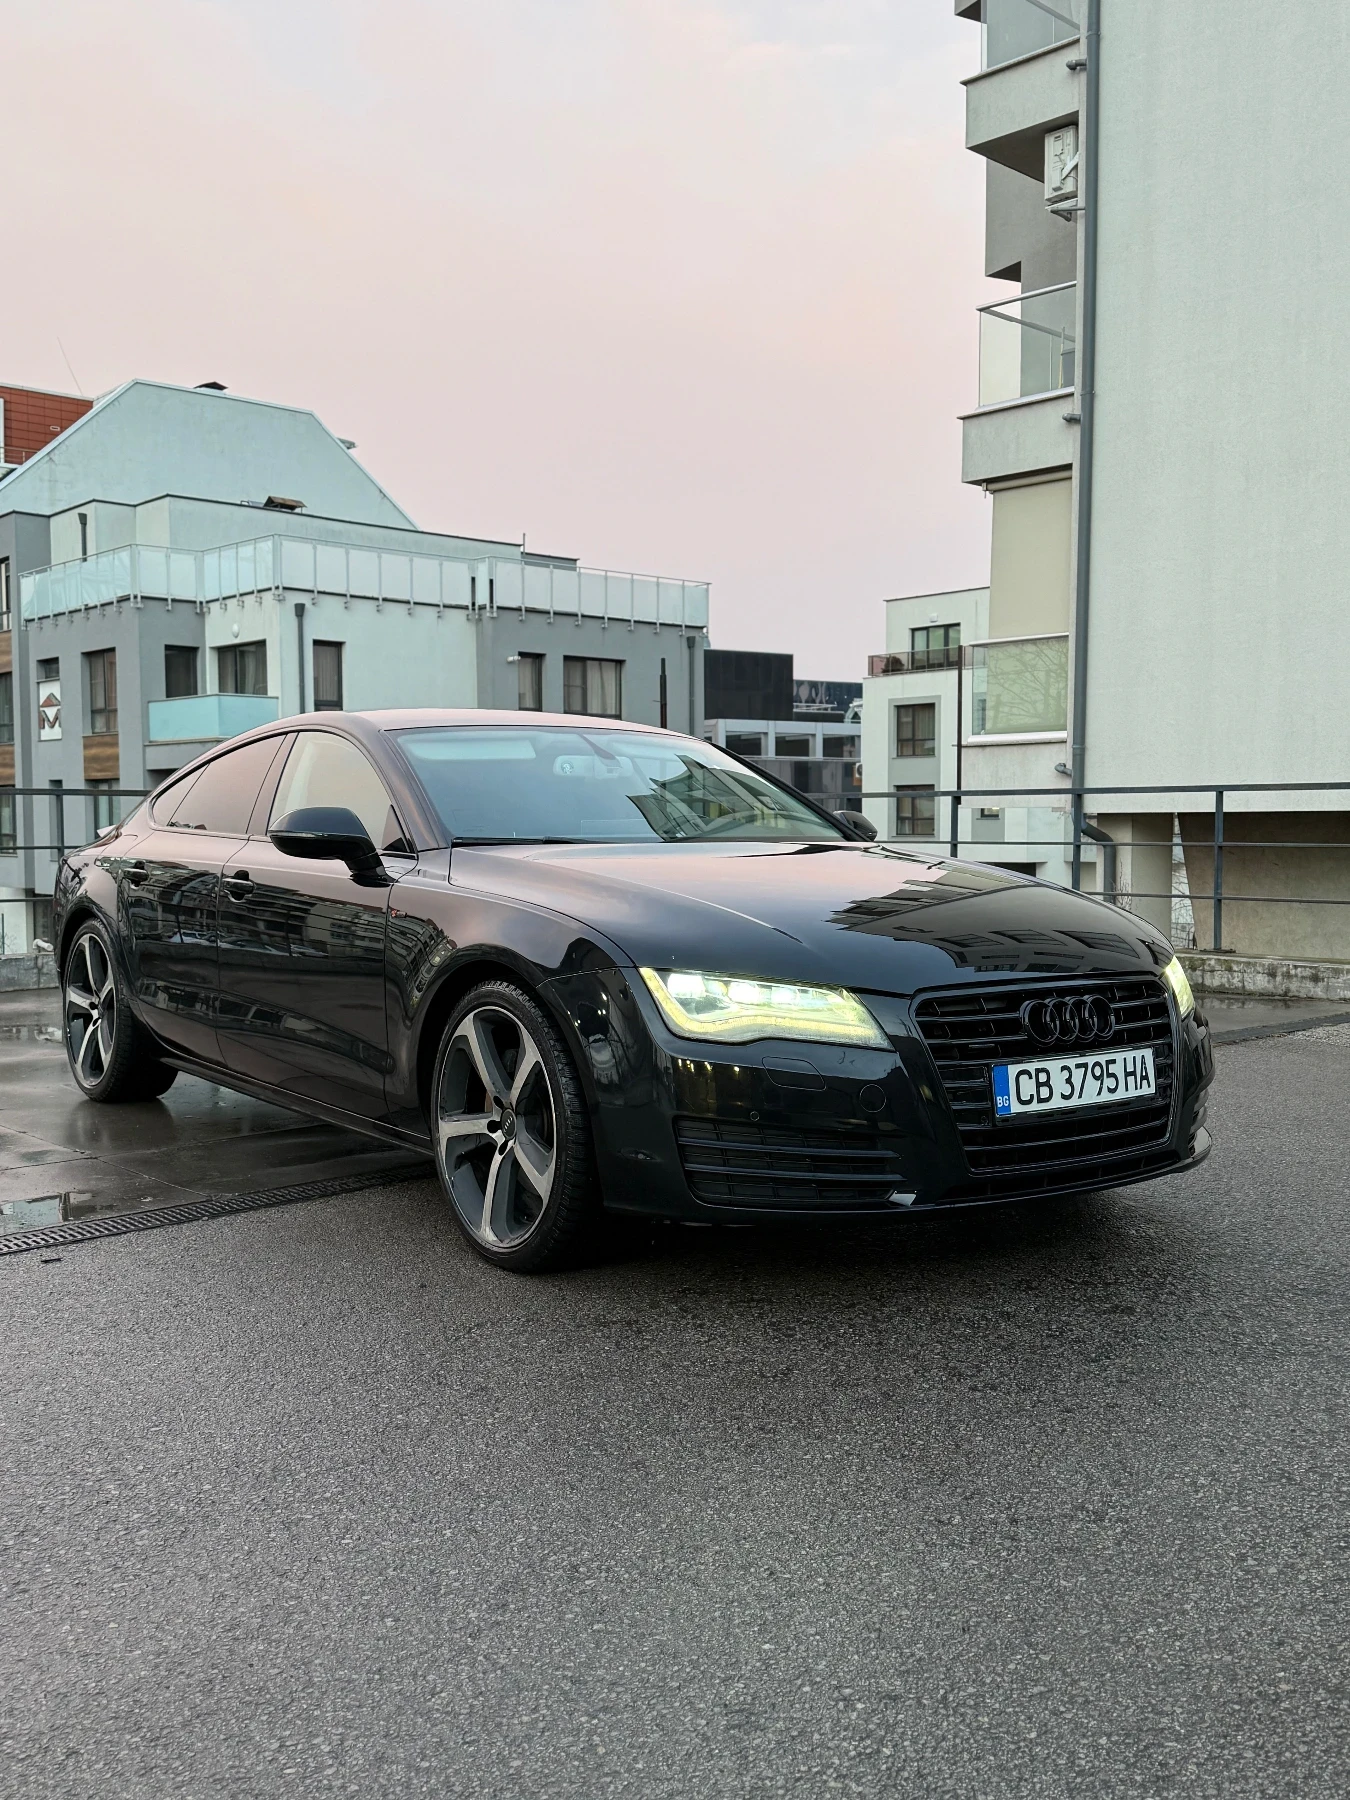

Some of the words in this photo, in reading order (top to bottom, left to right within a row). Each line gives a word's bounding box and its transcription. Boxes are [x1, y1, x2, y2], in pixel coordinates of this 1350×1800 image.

[1015, 1067, 1053, 1105] CB
[1060, 1058, 1119, 1100] 3795
[1123, 1054, 1151, 1092] HA
[997, 1096, 1009, 1107] BG
